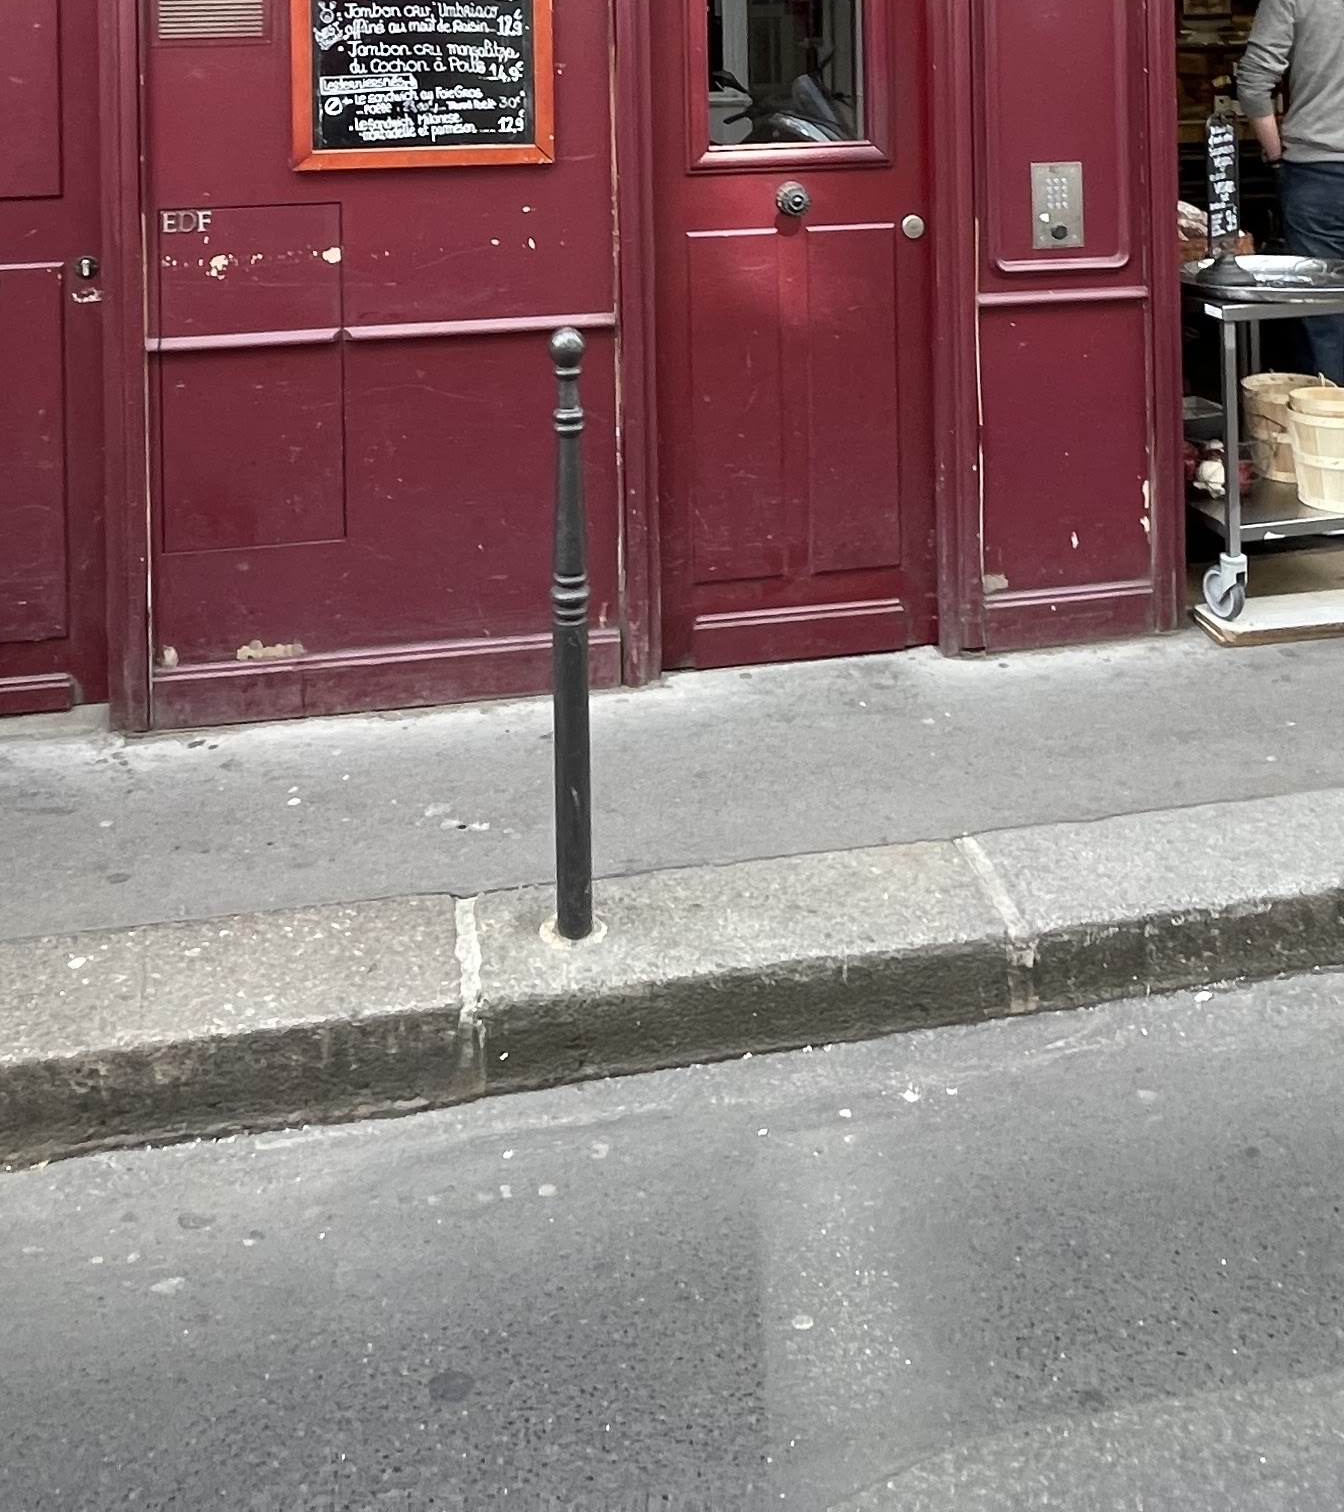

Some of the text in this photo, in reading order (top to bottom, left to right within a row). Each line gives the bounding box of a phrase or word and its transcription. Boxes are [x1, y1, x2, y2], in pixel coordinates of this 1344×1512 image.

[344, 3, 401, 19] Jambon
[347, 41, 411, 57] Jambon
[370, 58, 430, 73] Cochon
[160, 210, 212, 233] EDF
